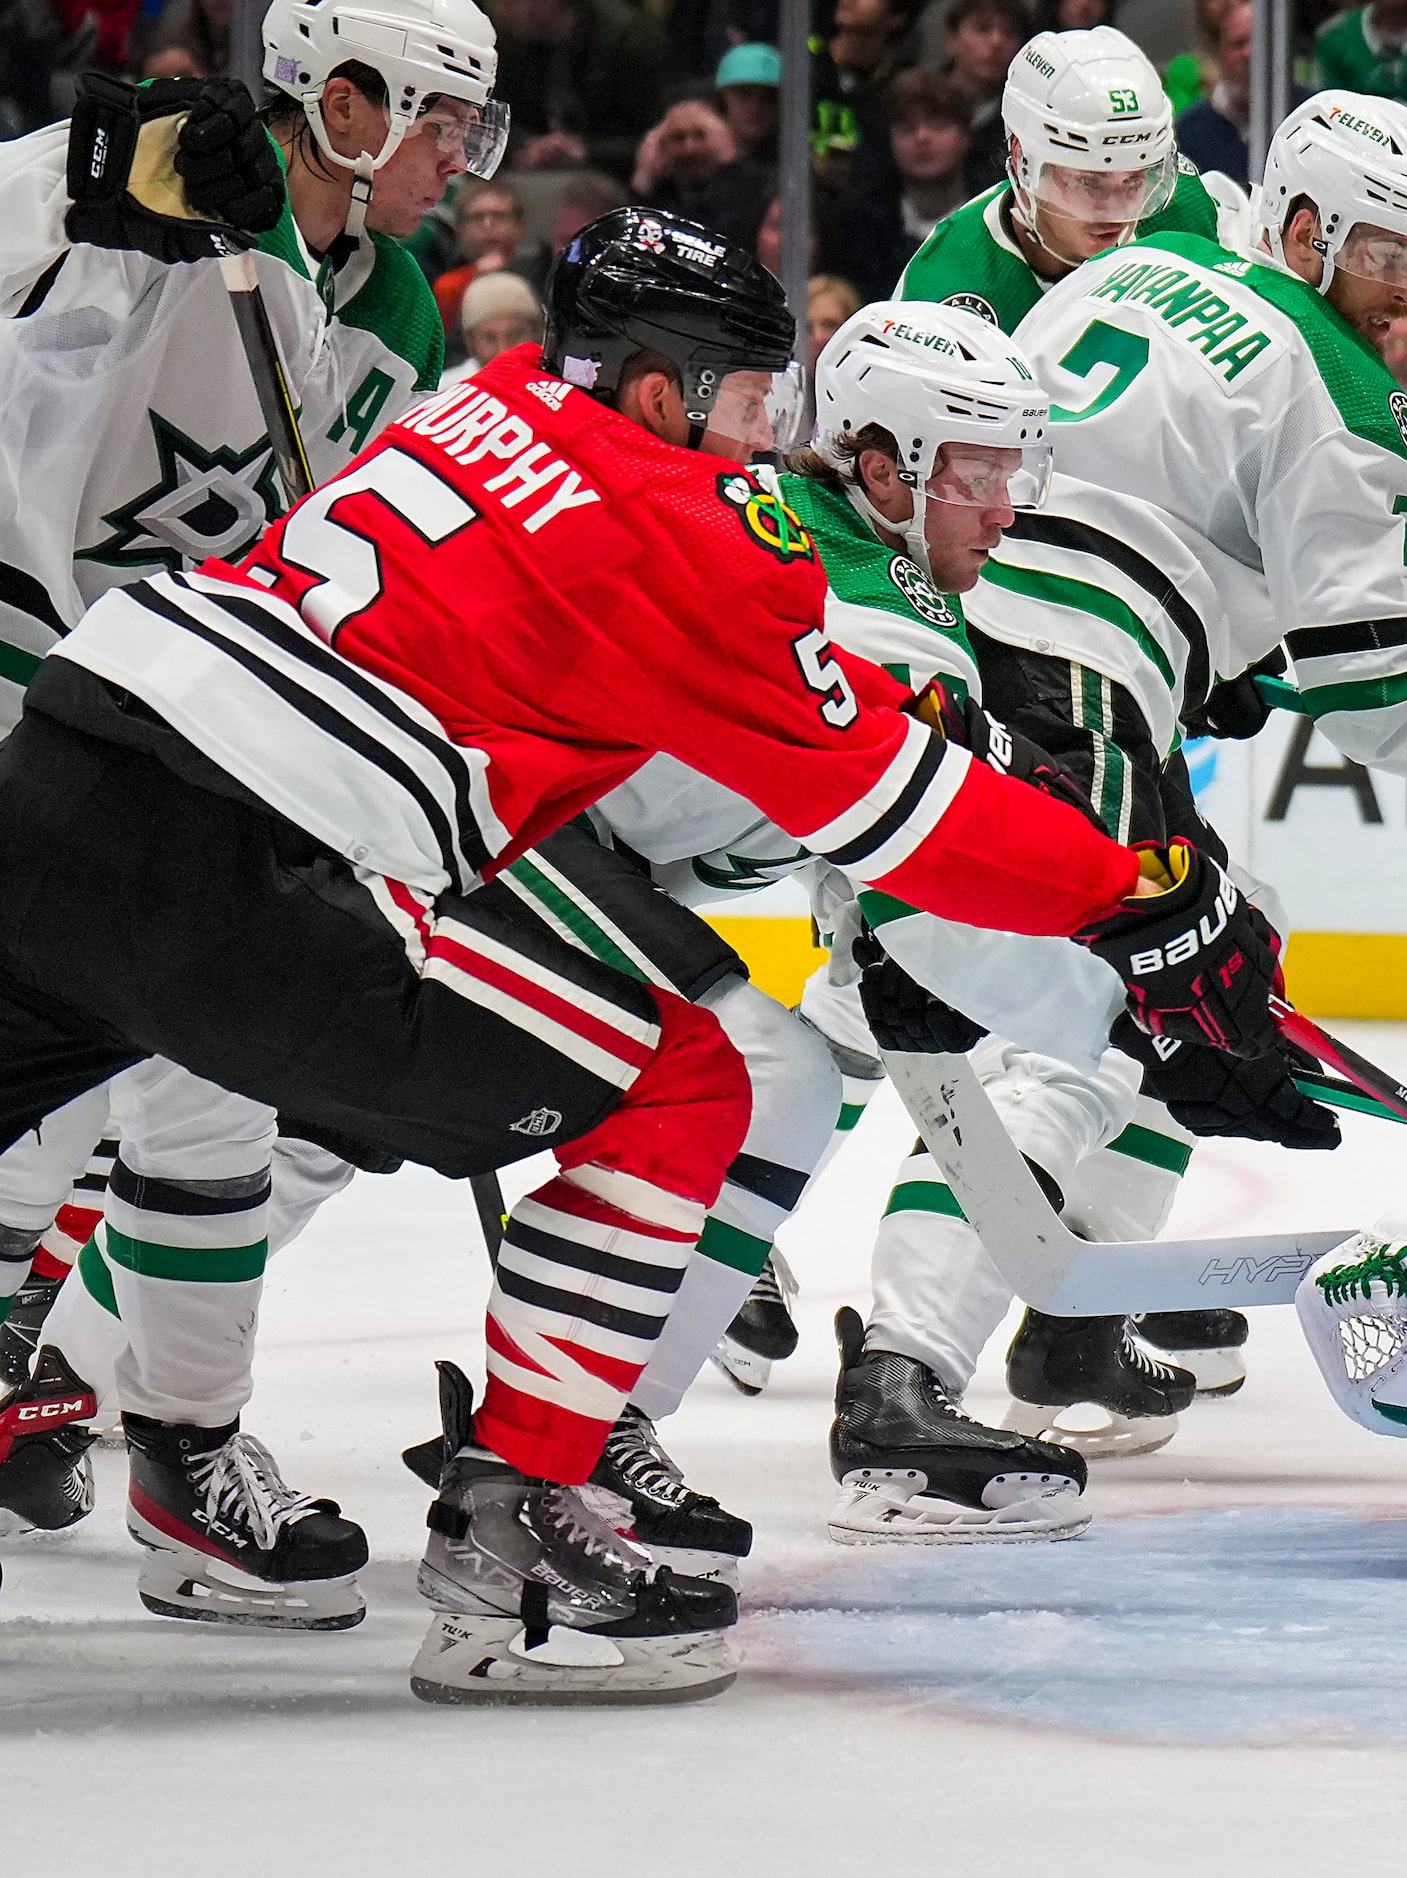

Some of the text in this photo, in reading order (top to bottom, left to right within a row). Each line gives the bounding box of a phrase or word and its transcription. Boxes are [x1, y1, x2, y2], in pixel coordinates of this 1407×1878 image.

[1108, 90, 1139, 113] 53
[1102, 132, 1152, 145] CCM
[1329, 107, 1390, 147] 7-ELEVEN
[91, 127, 106, 179] CCM
[676, 244, 717, 268] TIRE
[883, 320, 957, 357] 7-ELEVEN
[326, 366, 396, 456] A
[525, 382, 562, 411] adidas
[793, 628, 857, 728] 5
[18, 1399, 83, 1421] CCM
[191, 1507, 249, 1549] CCM
